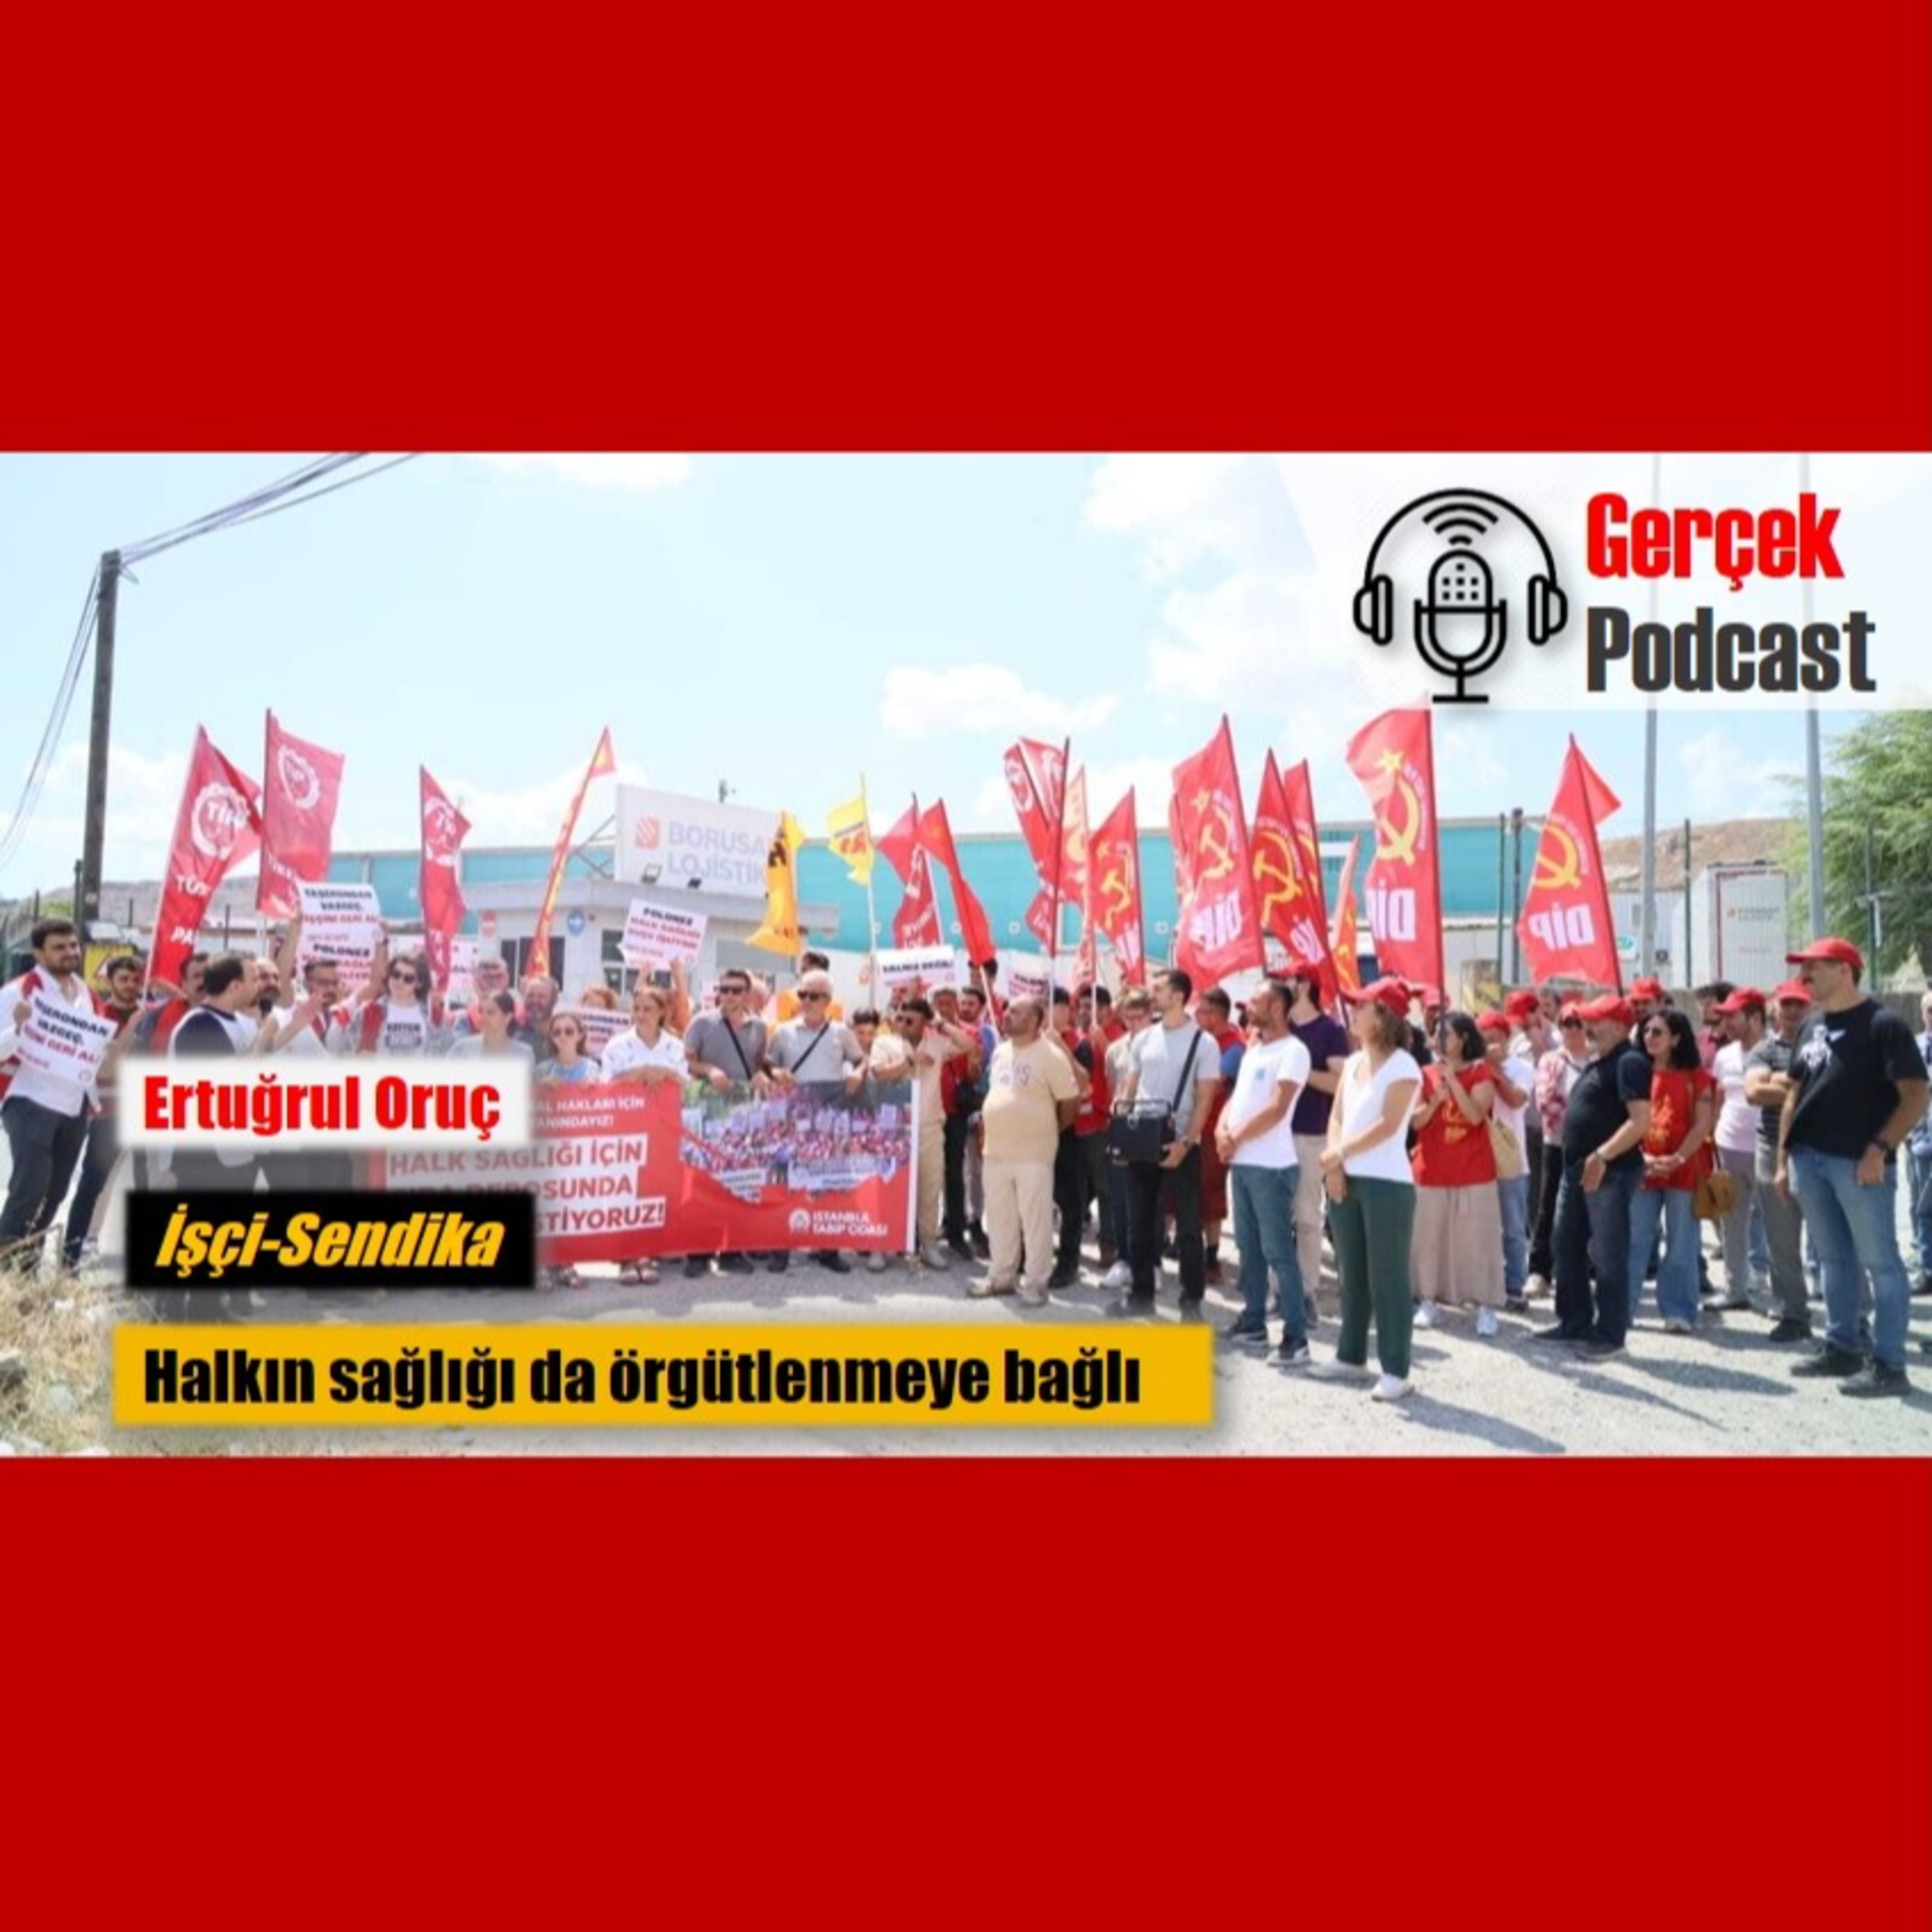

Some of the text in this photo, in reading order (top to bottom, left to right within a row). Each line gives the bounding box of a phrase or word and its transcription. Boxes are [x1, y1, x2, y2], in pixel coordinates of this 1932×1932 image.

[668, 822, 765, 855] BORUSA
[556, 1097, 616, 1110] HAKLARI
[535, 1114, 614, 1128] ANINDAYIZ!
[391, 1150, 465, 1176] HALK
[591, 1137, 642, 1168] İÇİN
[535, 1202, 665, 1233] STİYORUZ!
